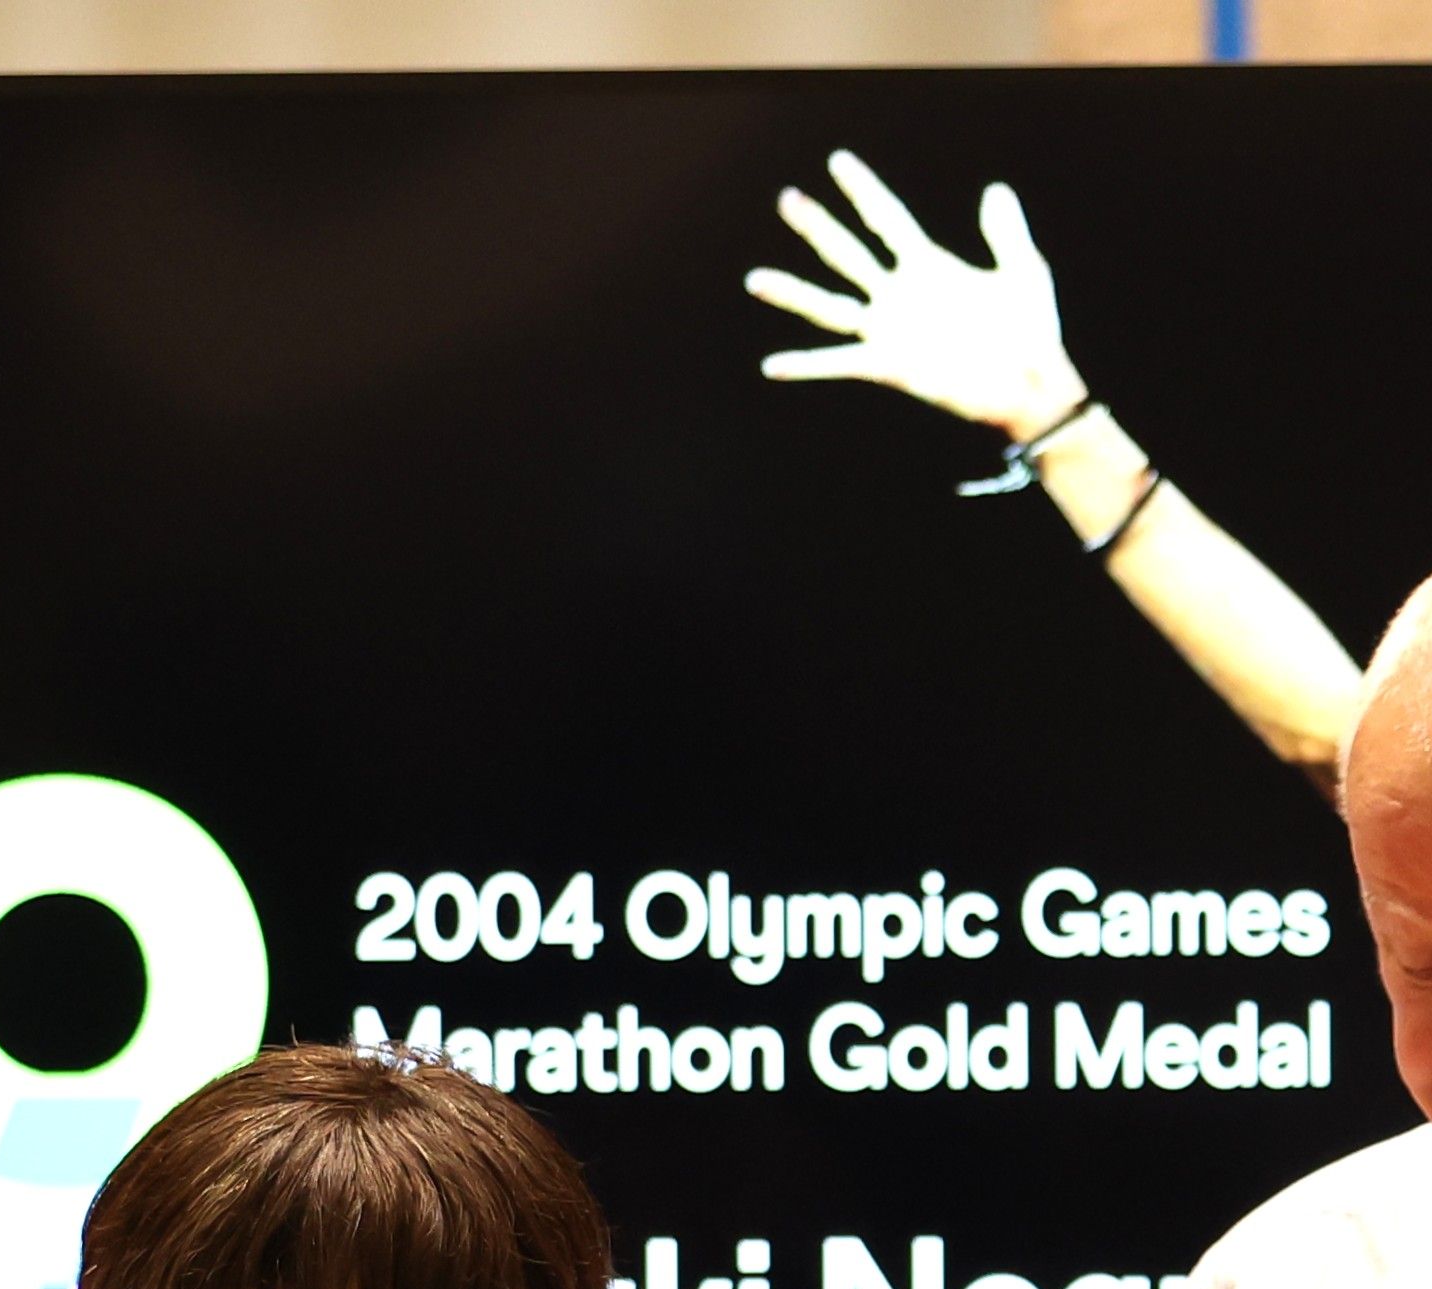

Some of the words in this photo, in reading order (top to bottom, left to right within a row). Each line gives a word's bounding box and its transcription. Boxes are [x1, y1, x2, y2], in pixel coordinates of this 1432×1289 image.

[354, 870, 605, 963] 2004
[624, 869, 1000, 986] Olympic
[1020, 867, 1332, 959] Games
[352, 1004, 786, 1094] Marathon
[807, 1001, 1030, 1092] Gold
[1053, 999, 1332, 1090] Medal
